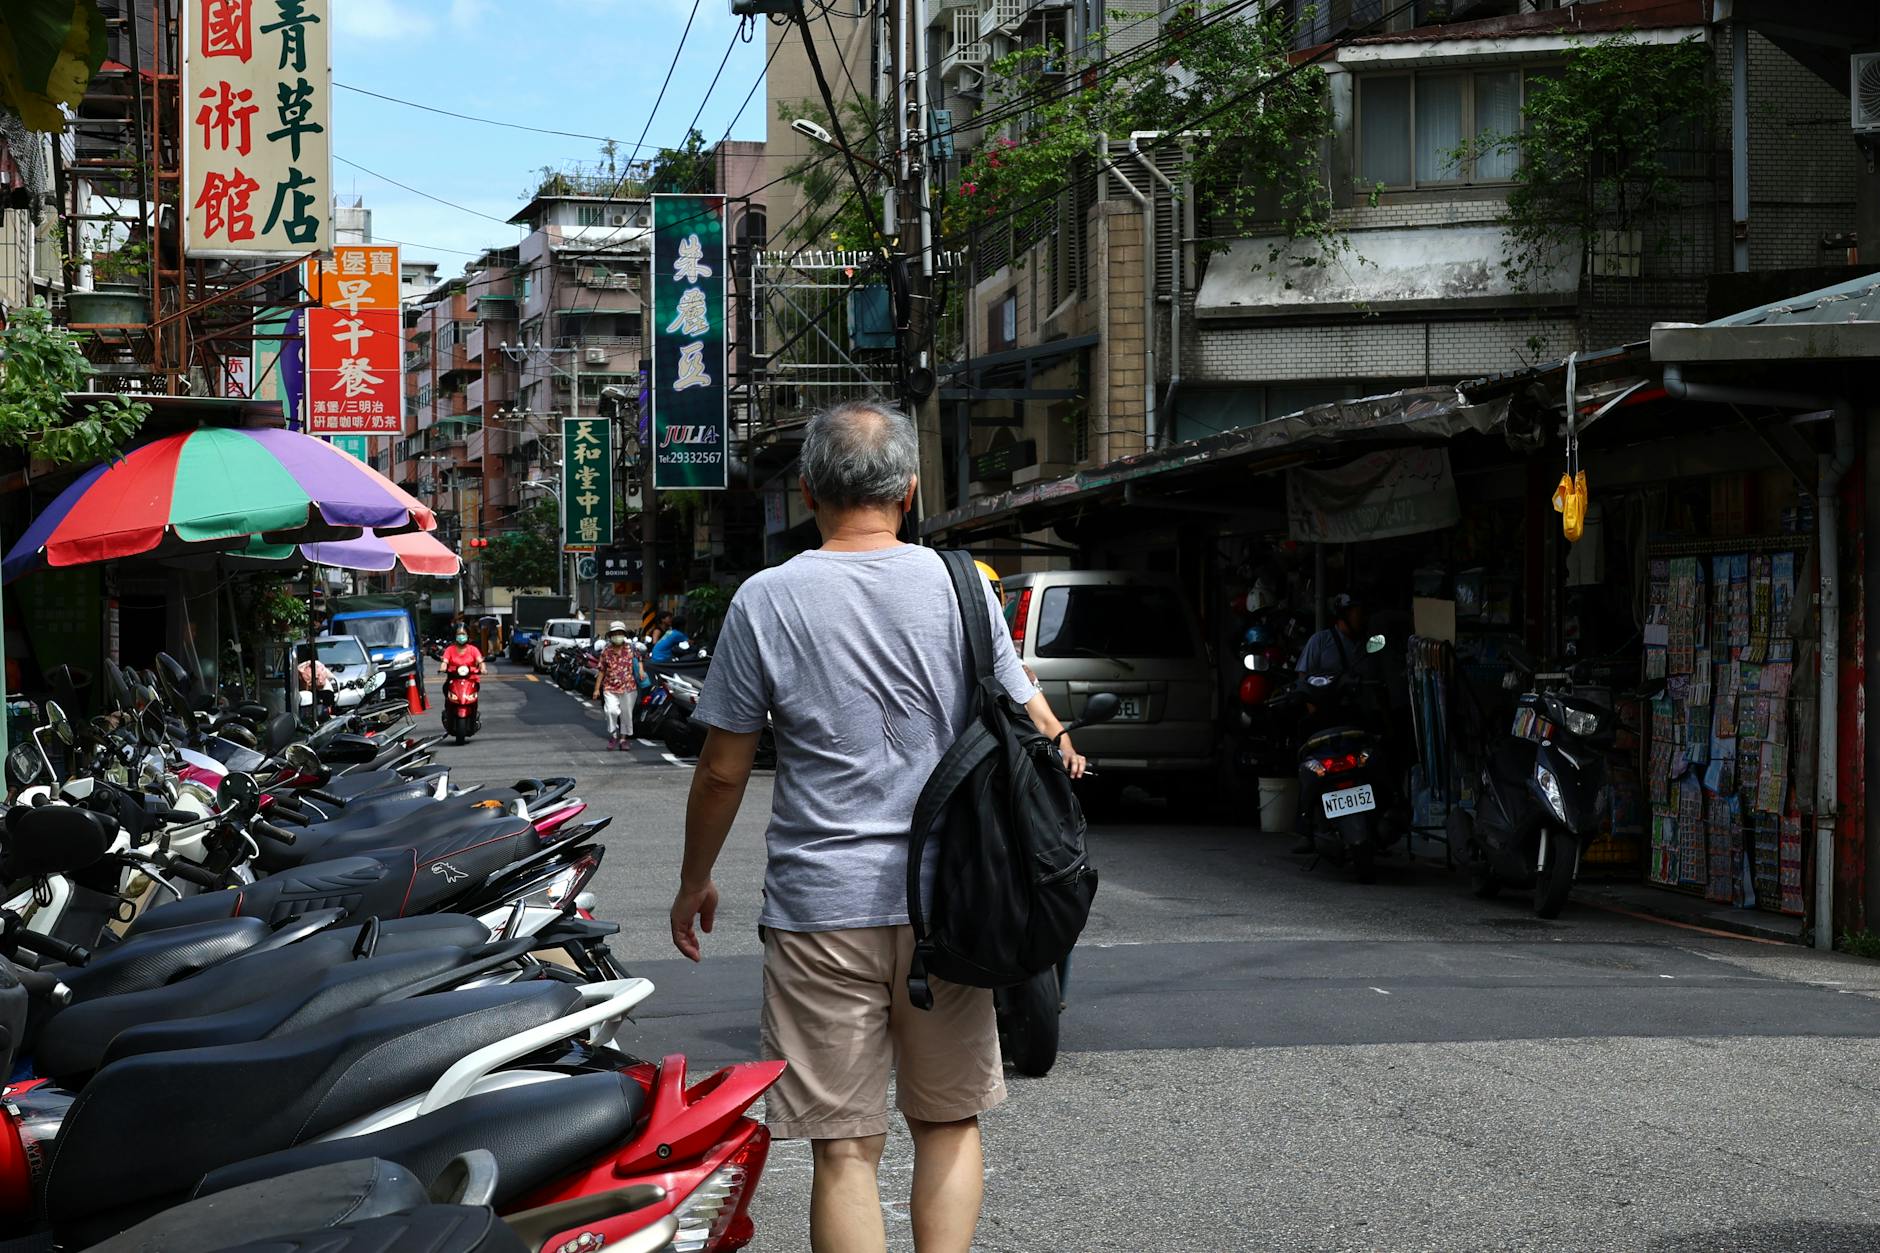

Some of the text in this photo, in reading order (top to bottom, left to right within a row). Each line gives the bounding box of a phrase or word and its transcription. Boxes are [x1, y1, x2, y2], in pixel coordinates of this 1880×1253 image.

[194, 0, 260, 243] 國術館
[260, 0, 324, 244] 青草店
[329, 279, 384, 398] 早午餐
[313, 401, 384, 414] 漢堡/三明治
[313, 415, 397, 429] 研磨咖啡/奶茶
[659, 424, 720, 448] JULIA
[573, 421, 602, 542] 天和堂中醫
